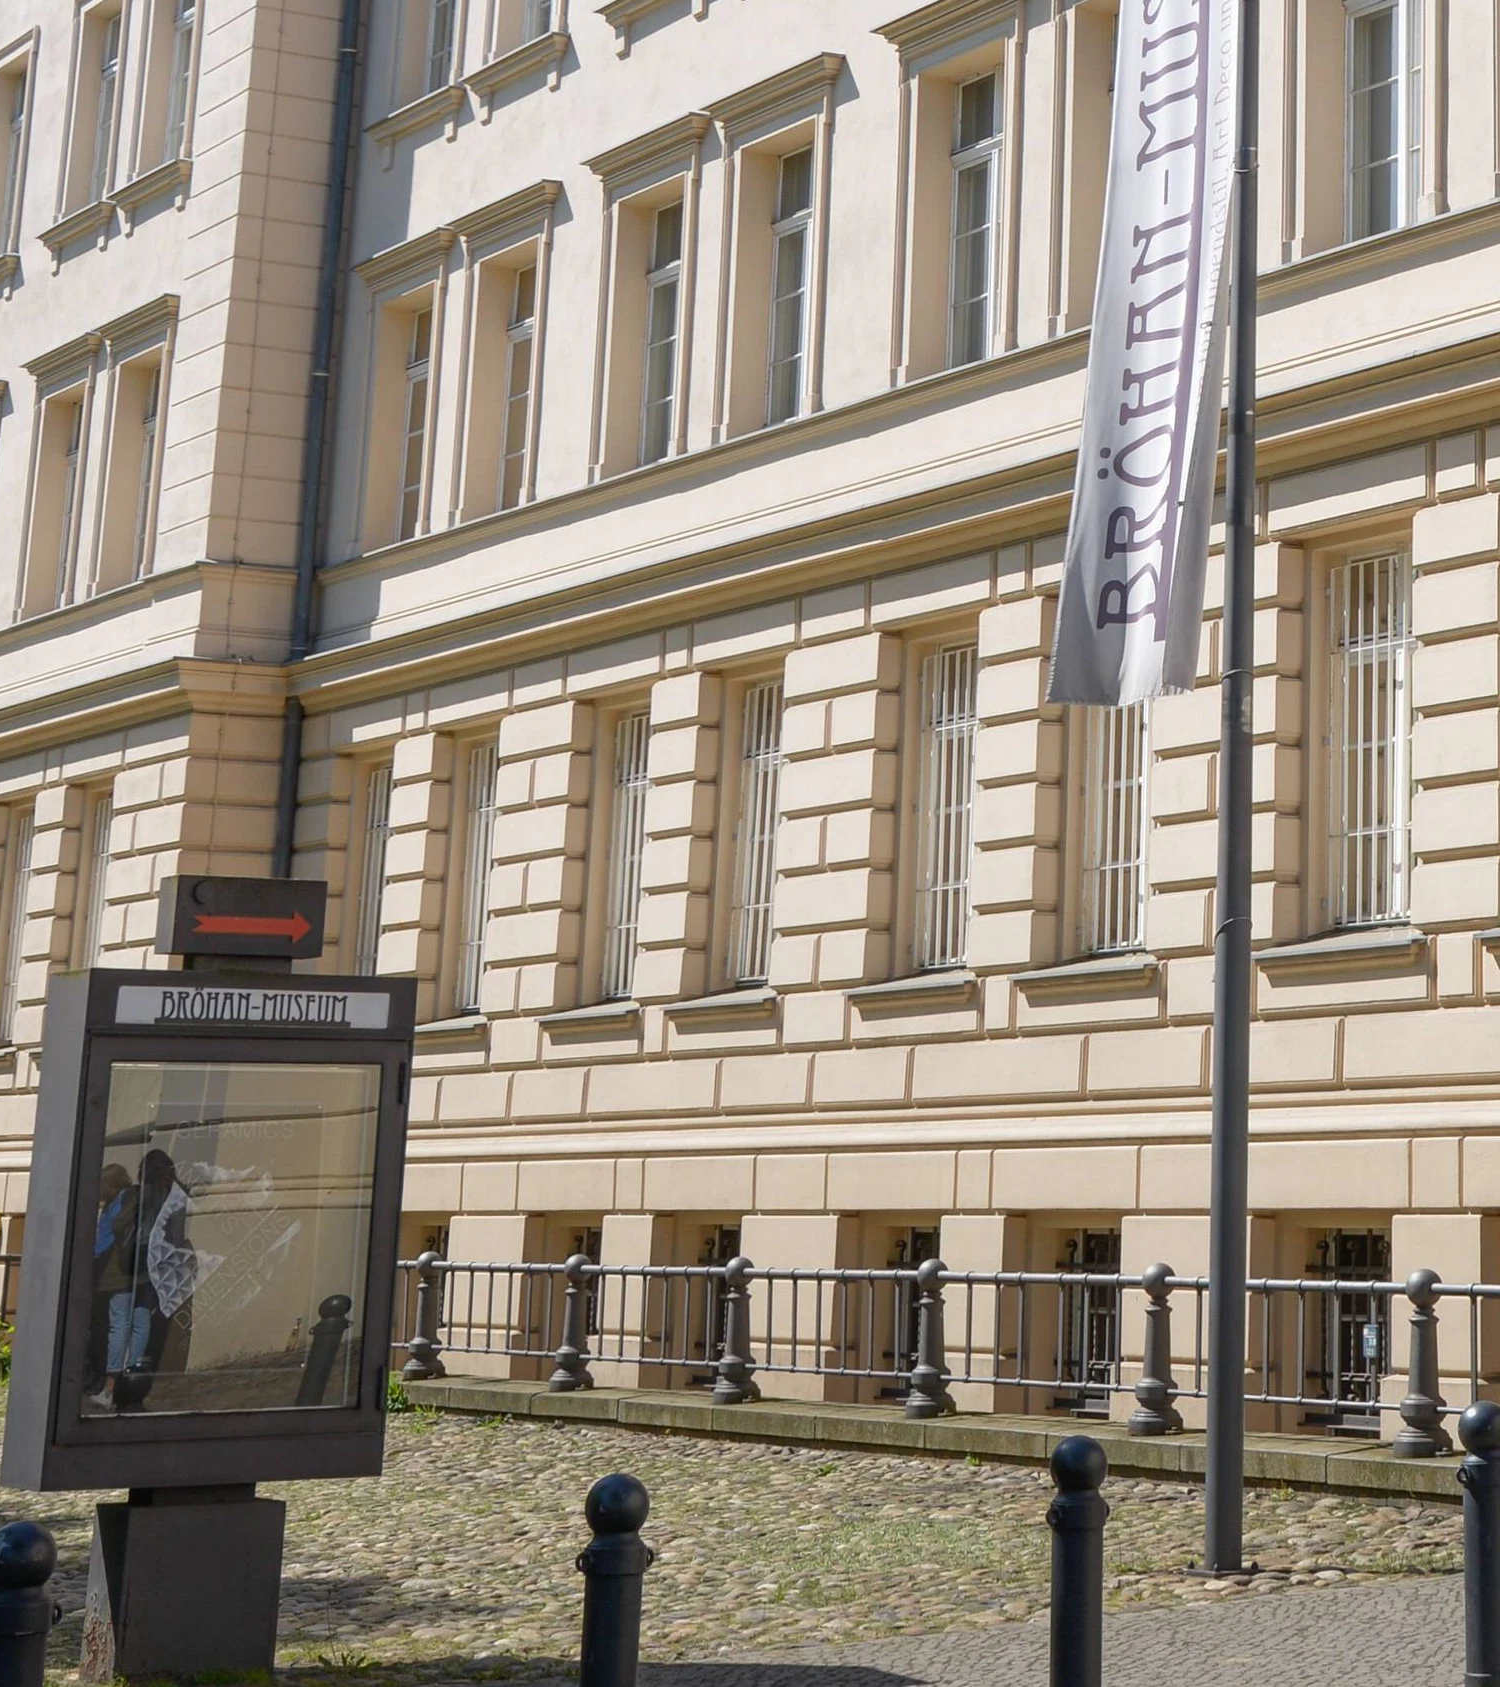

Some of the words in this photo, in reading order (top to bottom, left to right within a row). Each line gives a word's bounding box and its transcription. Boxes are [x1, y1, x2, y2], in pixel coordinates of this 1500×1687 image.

[1214, 39, 1231, 106] Deco
[1212, 116, 1228, 161] Art
[161, 987, 349, 1022] BRÖHAN-MUSEUM
